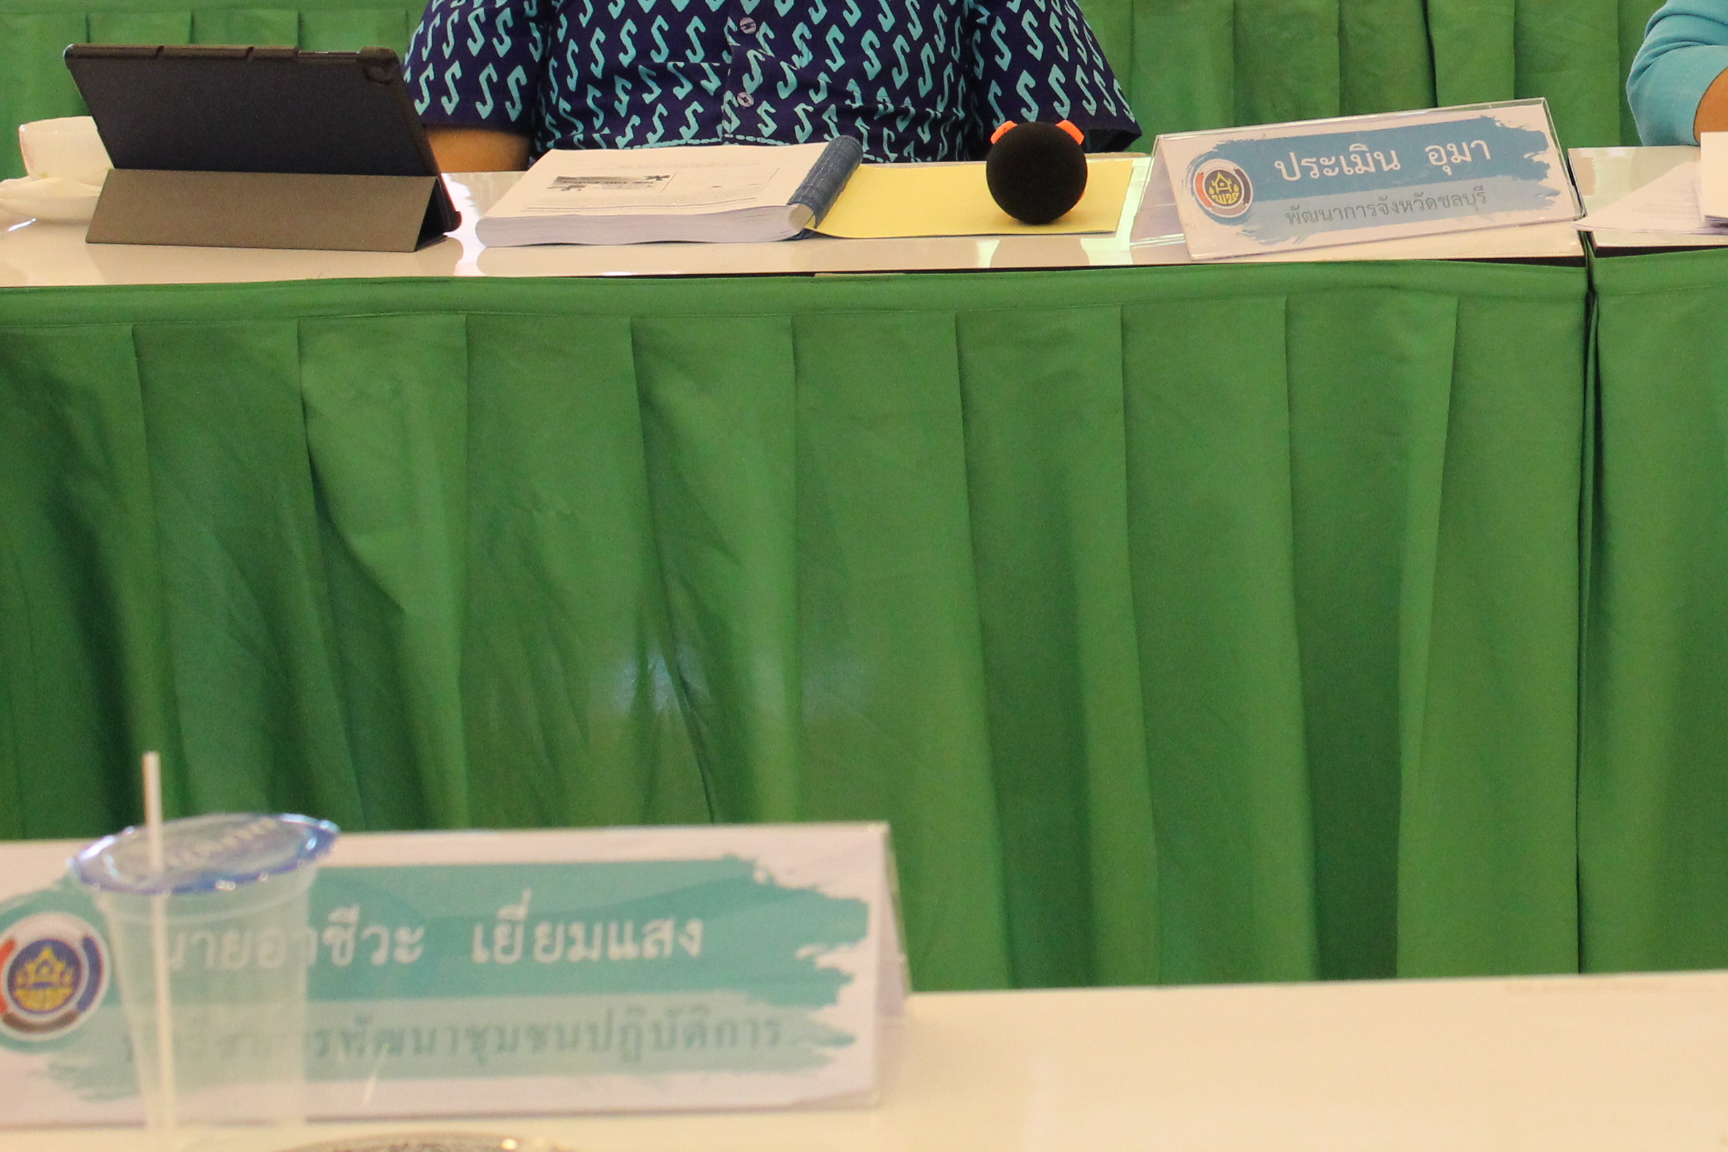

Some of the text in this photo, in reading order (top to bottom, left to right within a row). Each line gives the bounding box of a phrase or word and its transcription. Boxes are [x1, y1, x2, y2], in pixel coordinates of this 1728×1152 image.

[1273, 139, 1492, 182] ประเมิน อุมา
[1284, 184, 1488, 226] พัฒนาการจังหวัดชลบุรี
[471, 887, 705, 965] เยี่ยมแสง
